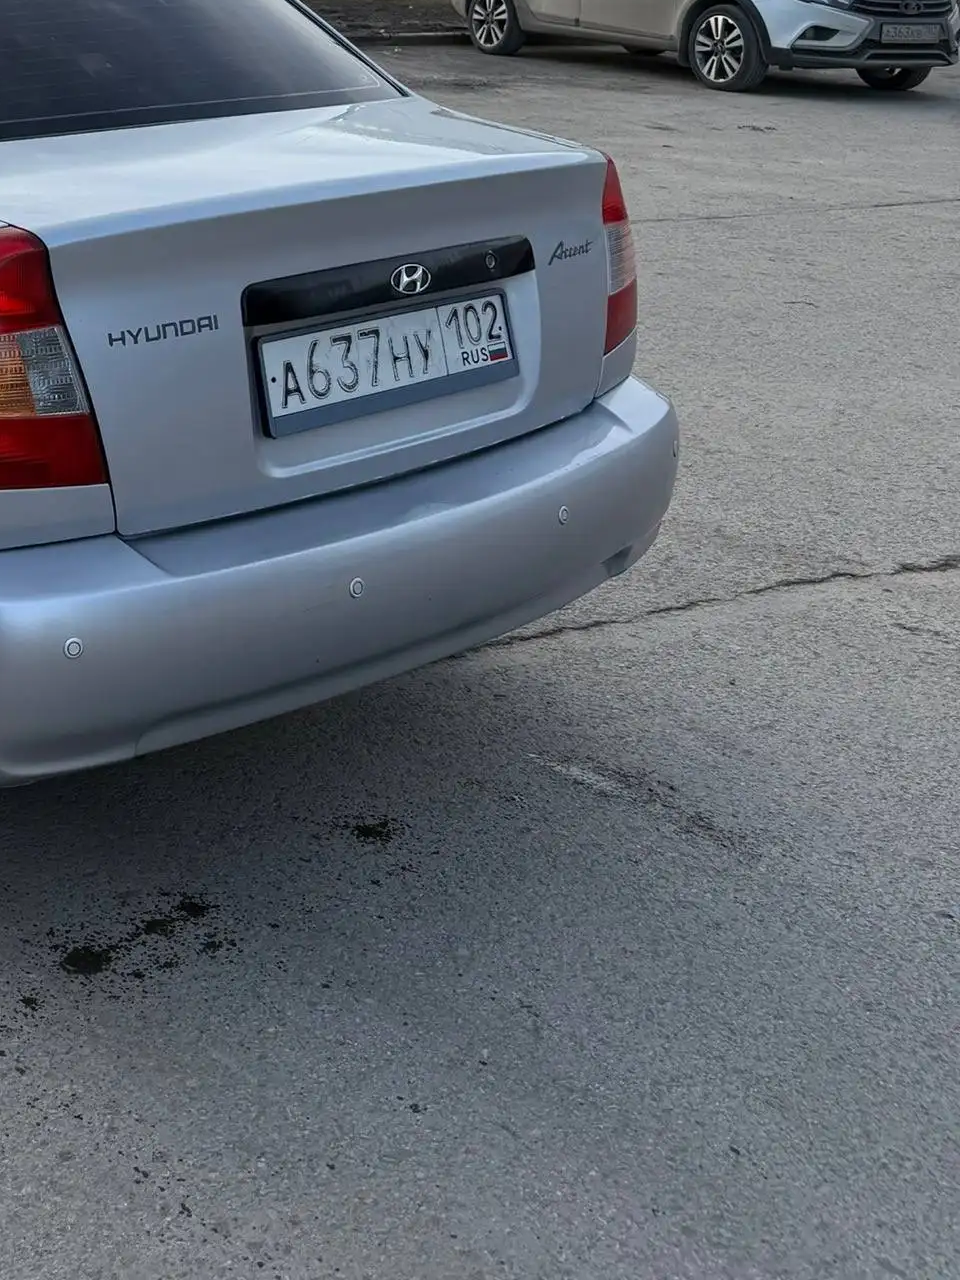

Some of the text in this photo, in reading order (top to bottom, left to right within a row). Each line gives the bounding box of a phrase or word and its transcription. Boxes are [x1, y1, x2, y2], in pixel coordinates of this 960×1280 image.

[548, 239, 593, 265] Accent
[108, 314, 219, 347] HYUNDAI
[462, 345, 489, 366] RUS
